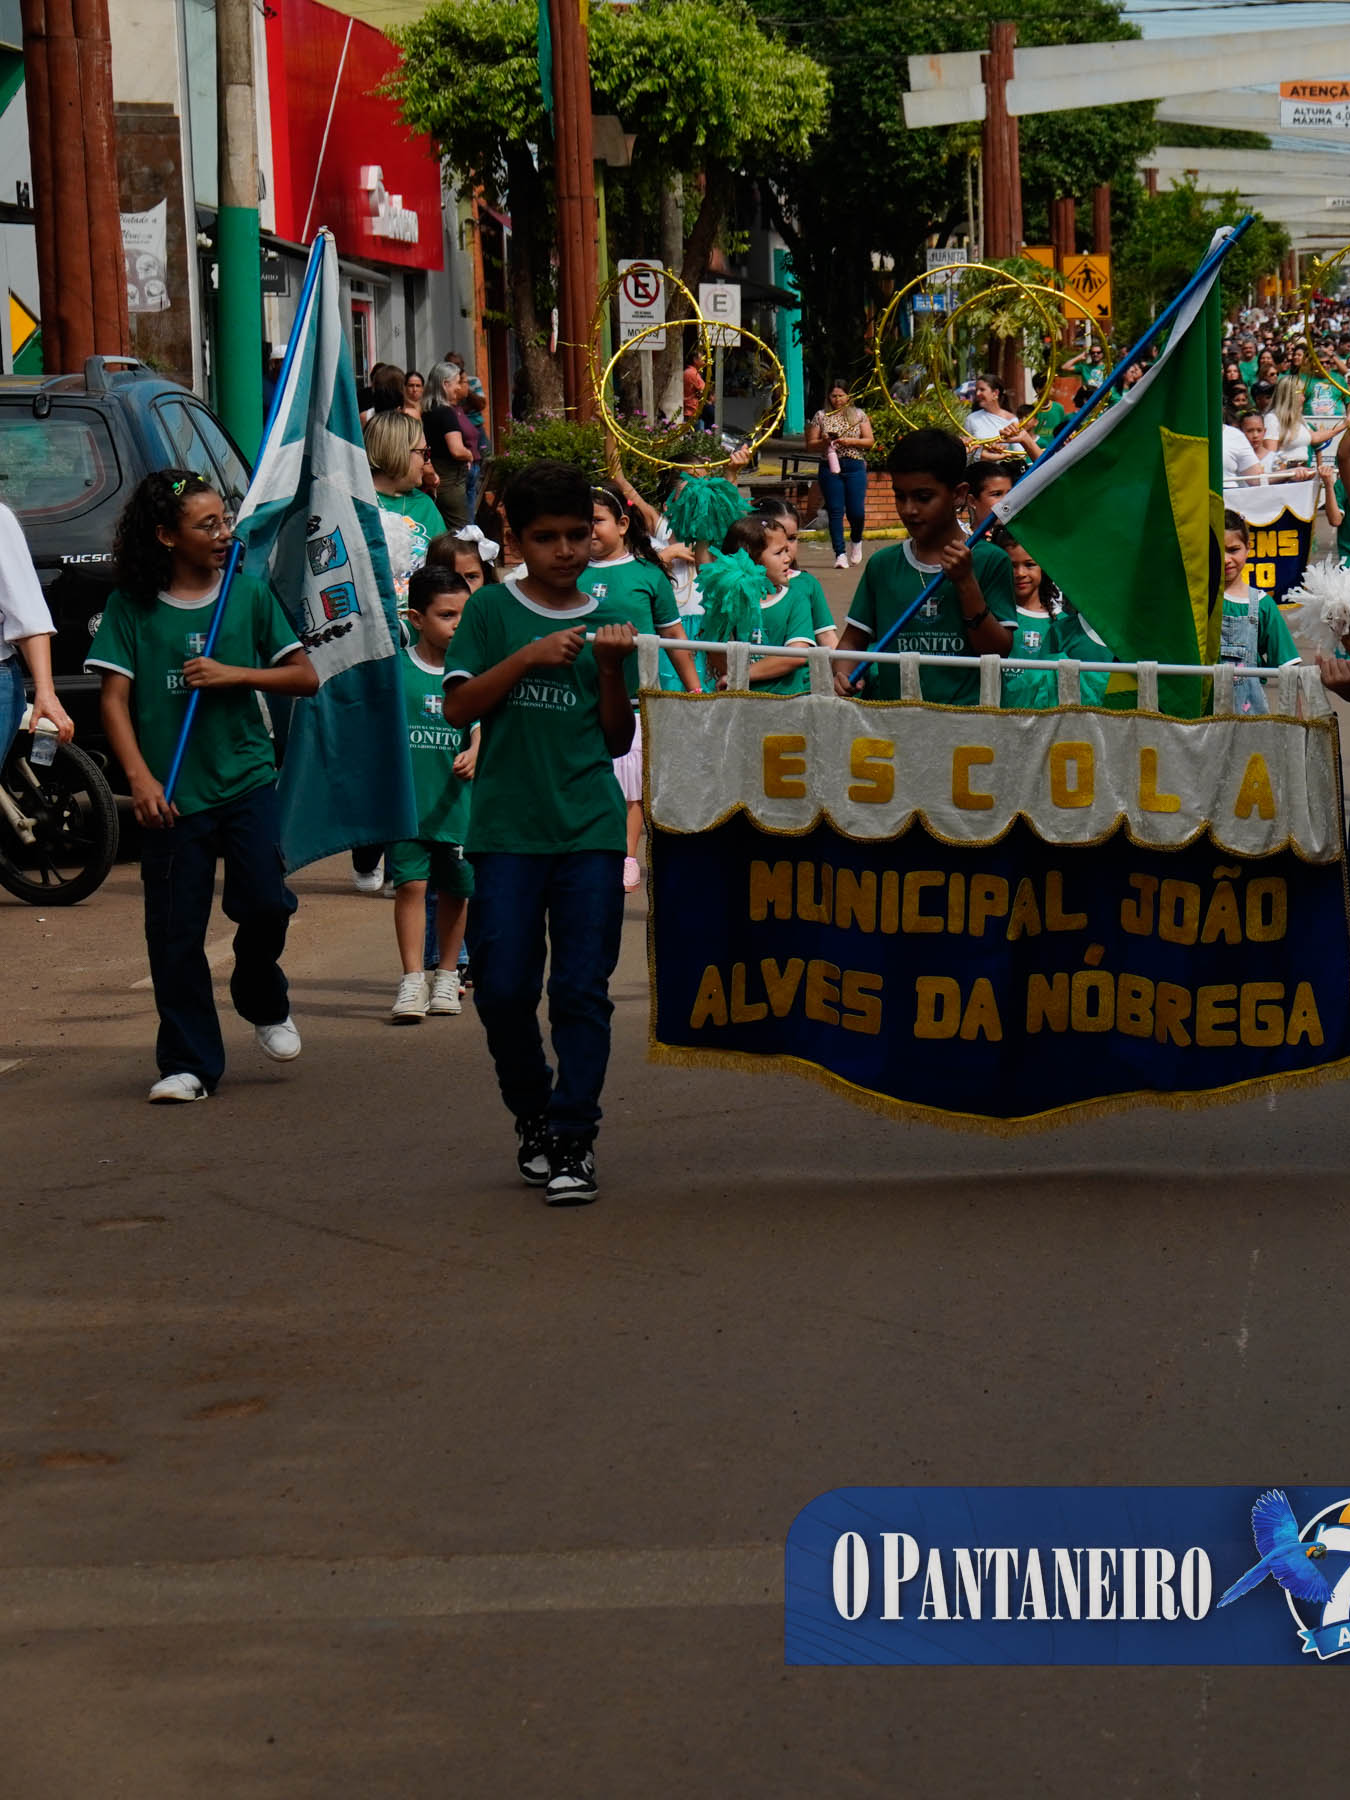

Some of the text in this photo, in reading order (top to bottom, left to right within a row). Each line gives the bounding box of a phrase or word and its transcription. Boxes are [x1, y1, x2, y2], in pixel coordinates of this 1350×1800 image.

[1293, 116, 1333, 125] MÁXIMA
[1294, 107, 1332, 116] ALTURA
[713, 294, 727, 312] E
[627, 328, 659, 339] MOOS
[897, 636, 965, 652] BONITO
[506, 682, 577, 707] ONITO
[409, 729, 462, 747] ONITO
[762, 735, 1277, 820] ESCOLA
[748, 860, 1290, 946] MUNICIPAL JOÃO
[688, 942, 1326, 1048] ALVES DA NÓBREGA
